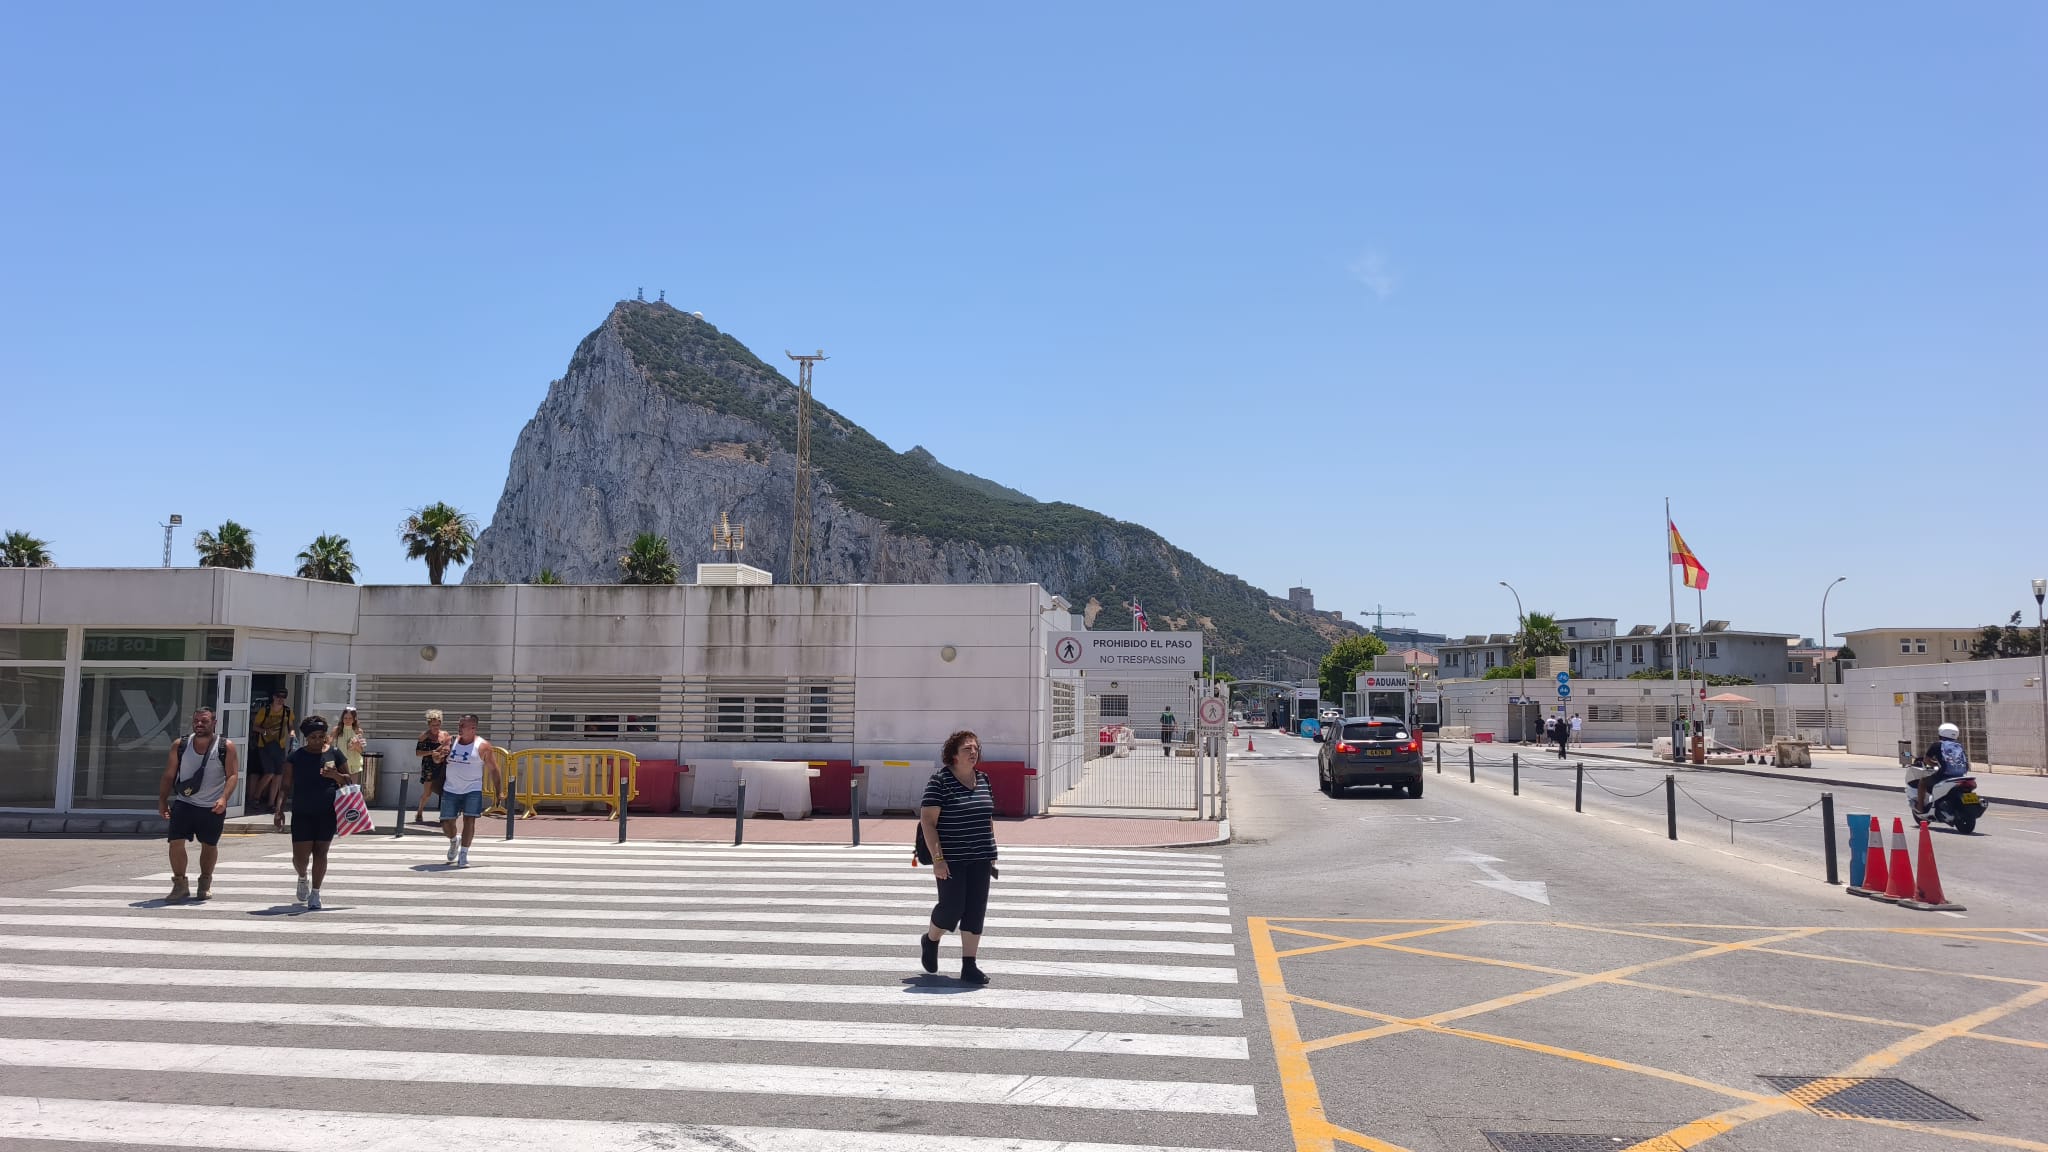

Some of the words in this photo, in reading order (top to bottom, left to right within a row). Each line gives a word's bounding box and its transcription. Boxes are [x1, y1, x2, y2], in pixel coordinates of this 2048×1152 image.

[1093, 639, 1148, 648] PROHIBIDO
[1150, 639, 1163, 648] EL
[1165, 640, 1193, 649] PASO
[1100, 655, 1115, 664] NO
[1117, 655, 1186, 665] TRESPASSING
[1375, 677, 1407, 687] ADUANA
